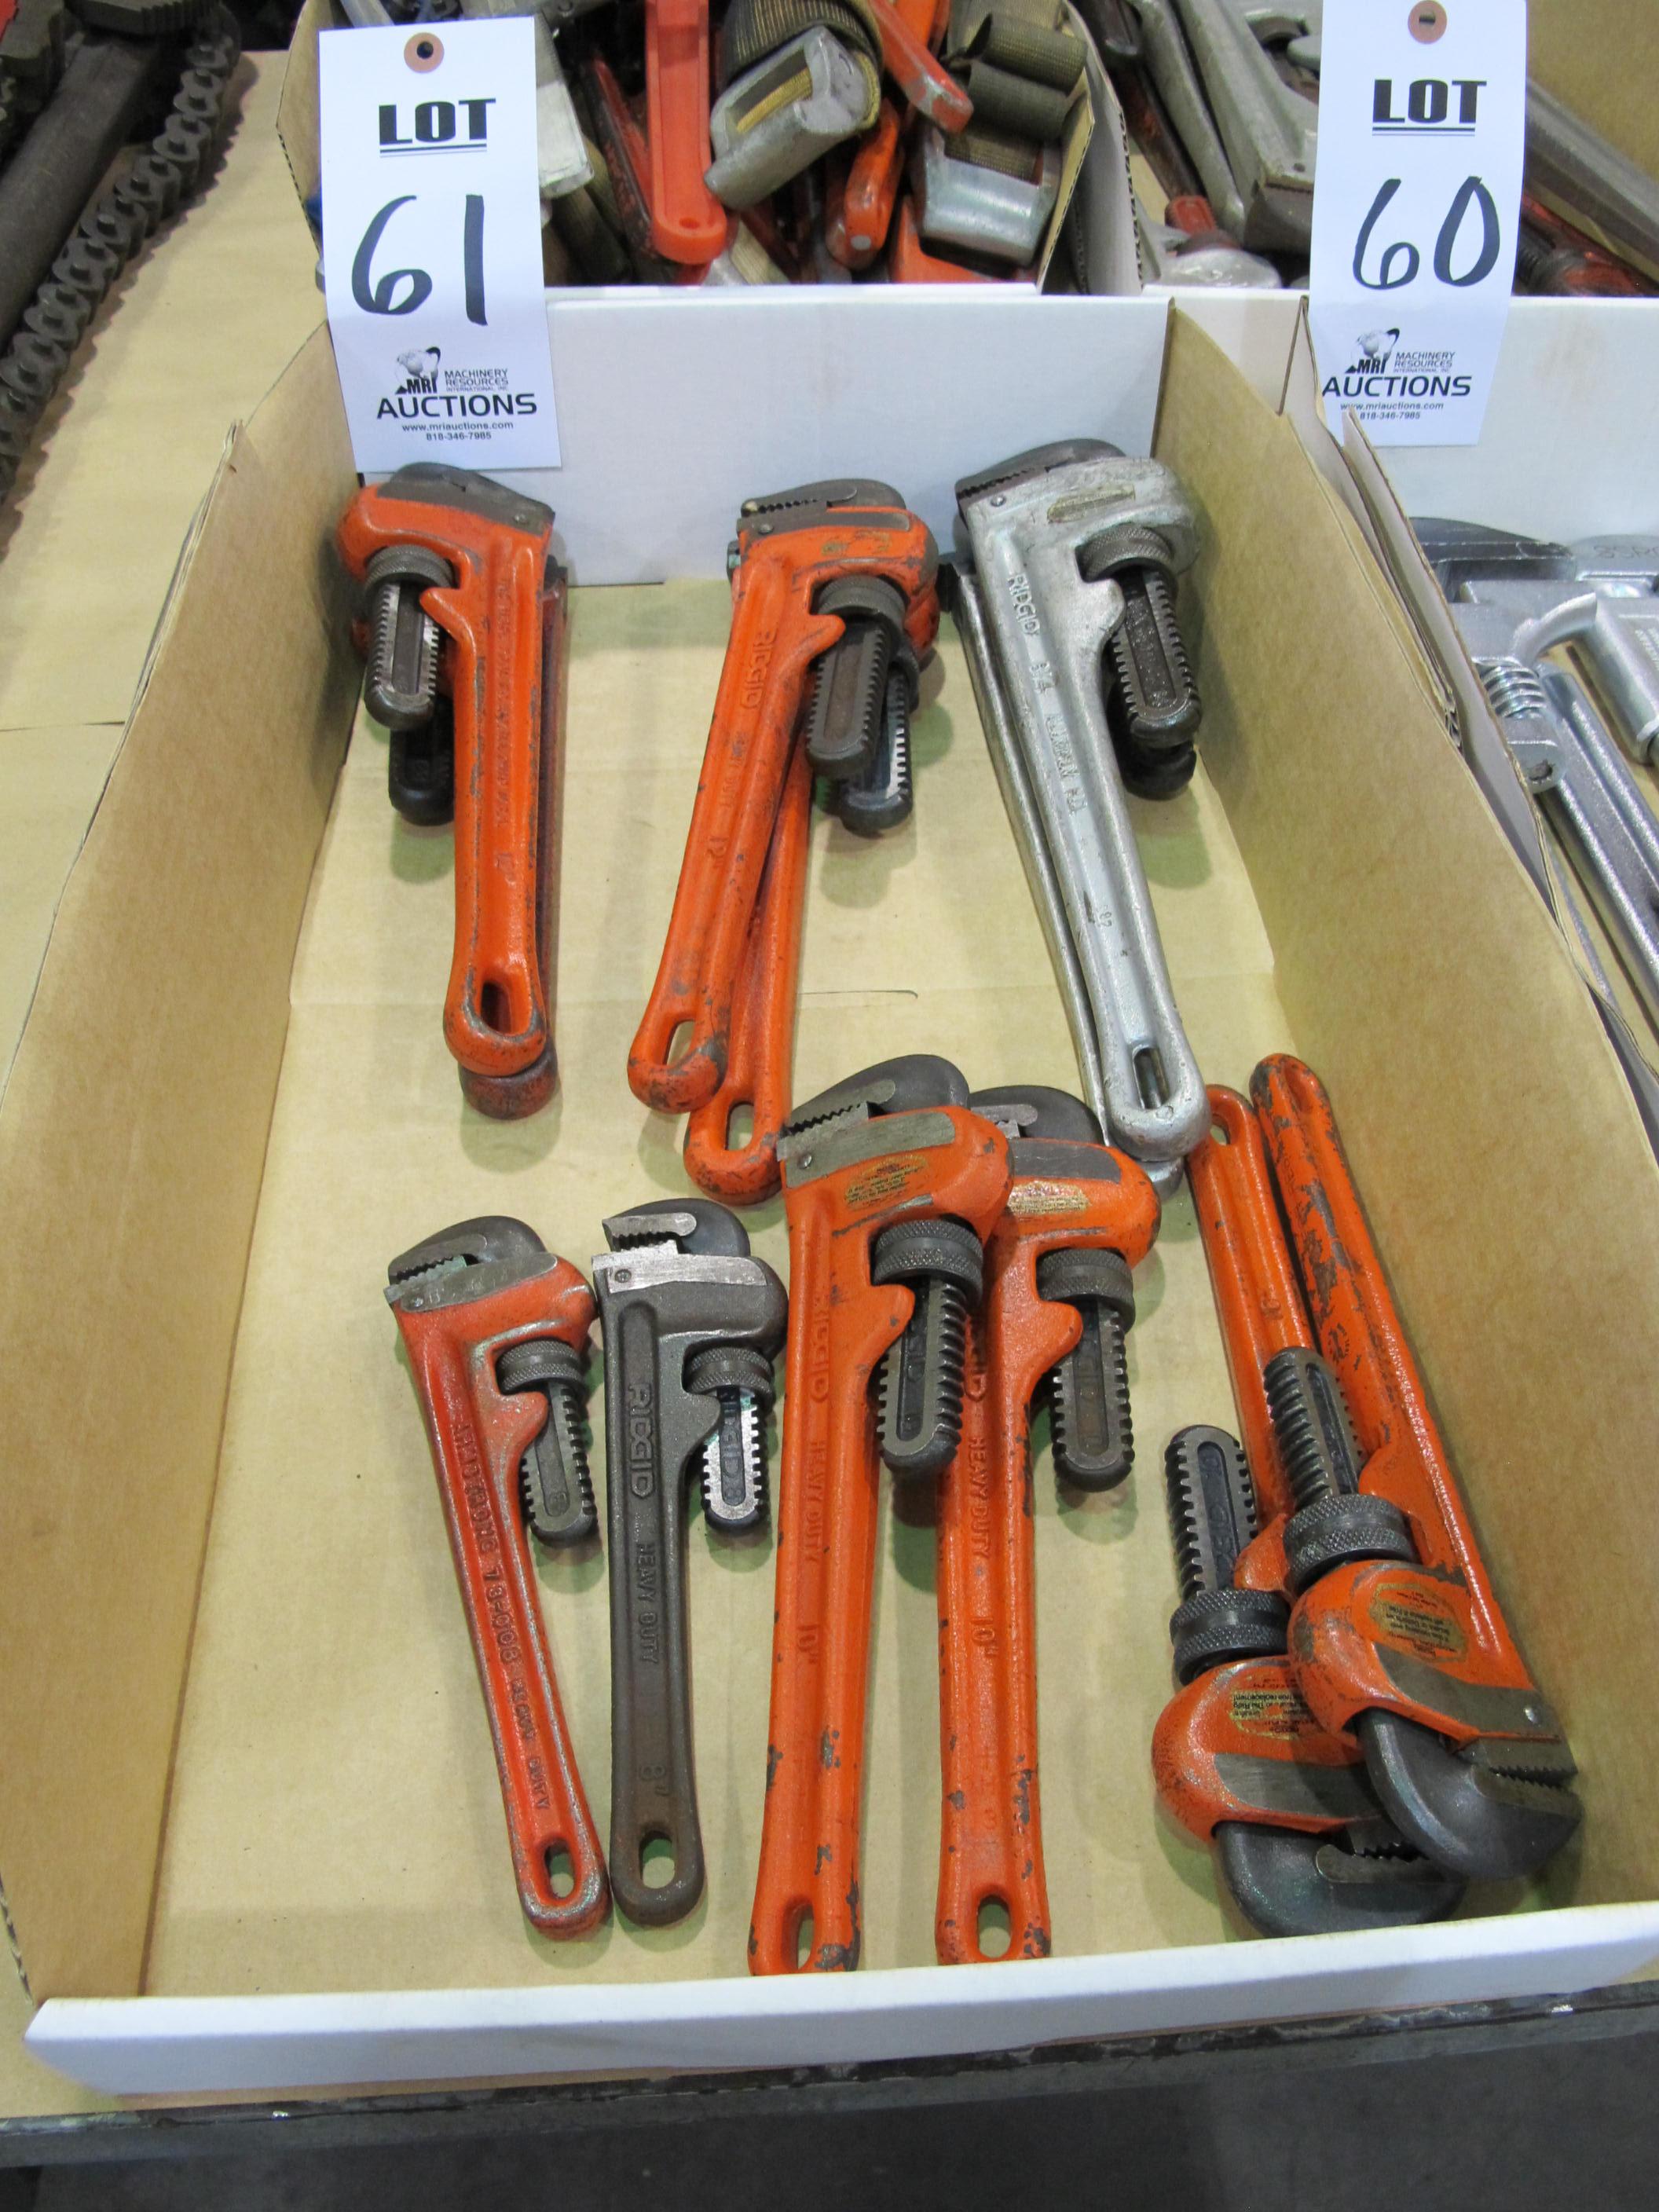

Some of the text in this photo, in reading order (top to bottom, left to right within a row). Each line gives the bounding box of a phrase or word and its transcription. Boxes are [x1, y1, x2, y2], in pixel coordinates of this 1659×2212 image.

[378, 97, 496, 145] LOT
[1372, 79, 1487, 124] LOT
[1352, 176, 1500, 290] 60
[350, 194, 488, 326] 61
[407, 377, 438, 394] MRI
[444, 368, 508, 379] MACHINERY
[445, 377, 509, 386] RESOURCES
[1322, 375, 1472, 397] AUCTIONS
[1357, 357, 1387, 374] MRI
[376, 393, 537, 419] AUCTIONS
[402, 421, 514, 431] www.mriauctions.com
[1340, 401, 1444, 411] www.mriauctions.com
[1360, 412, 1421, 420] 818-346-7985
[426, 432, 492, 441] 818-346-7985
[1008, 573, 1041, 635] RIDGID
[742, 628, 778, 709] RIDGID
[628, 1382, 655, 1500] RIDGID
[804, 1439, 826, 1502] HEAVY
[966, 1437, 988, 1499] HEAVY
[803, 1511, 823, 1563] DUTY
[968, 1505, 990, 1558] DUTY
[635, 1541, 658, 1602] HEAVY
[638, 1611, 659, 1665] DUTY
